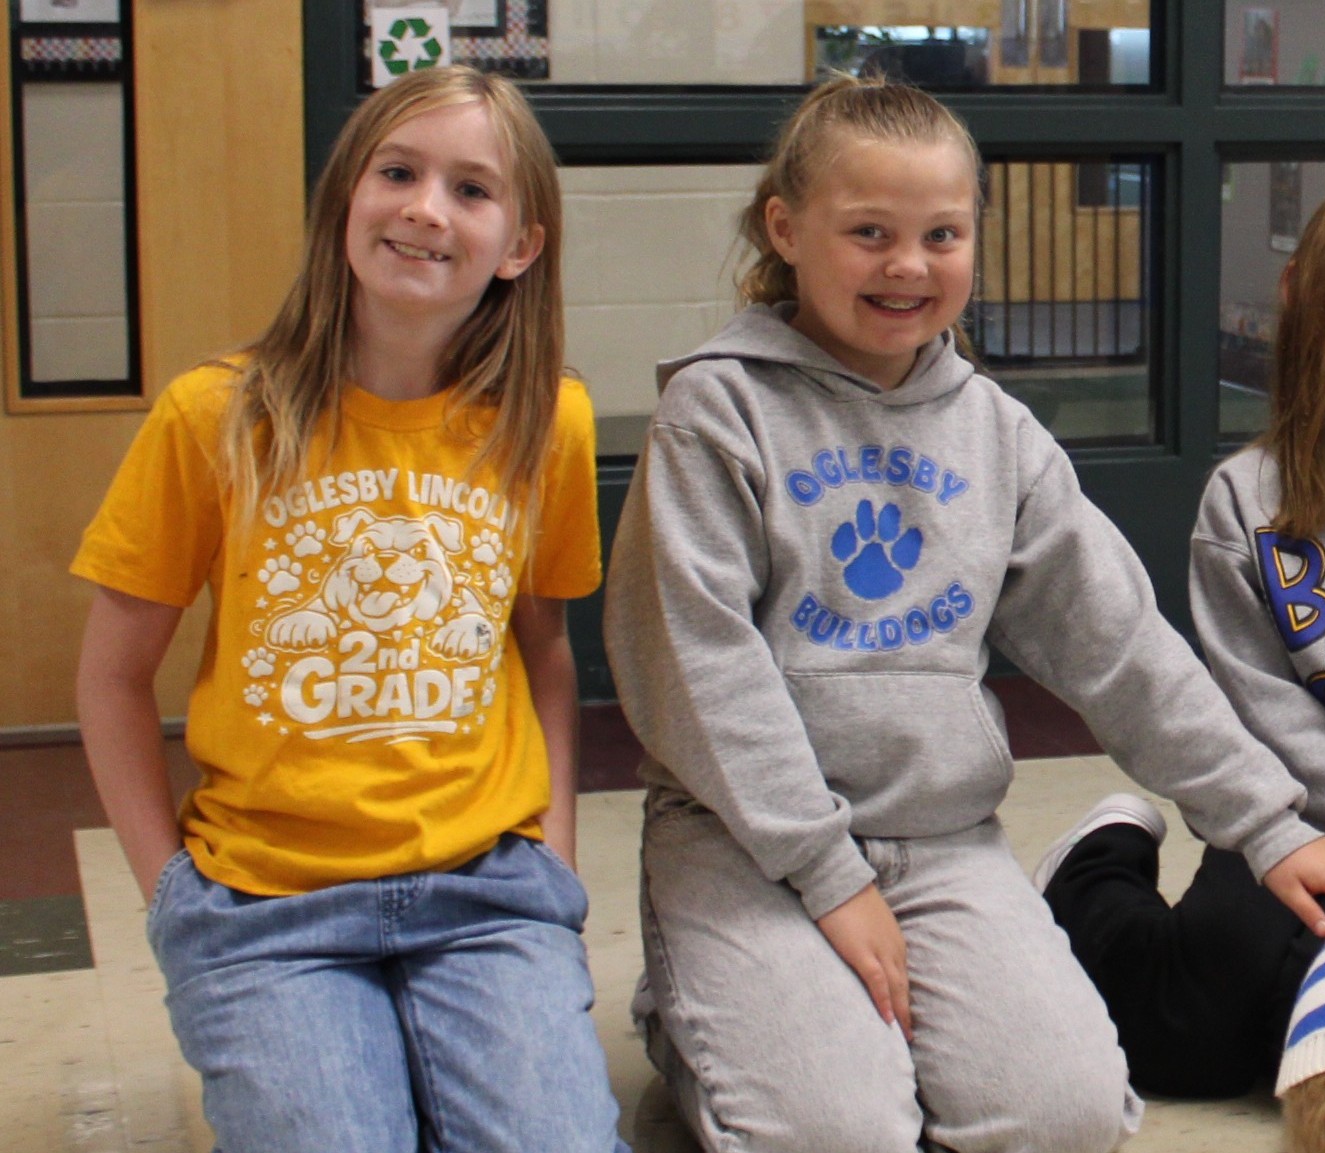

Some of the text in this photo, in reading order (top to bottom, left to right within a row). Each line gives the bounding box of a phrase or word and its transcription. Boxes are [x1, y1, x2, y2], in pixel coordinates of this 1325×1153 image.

[263, 468, 399, 529] OGLESBY
[785, 445, 969, 507] OGLESBY
[790, 581, 975, 652] BULLDOGS
[338, 631, 420, 674] 2nd
[281, 656, 481, 725] GRADE
